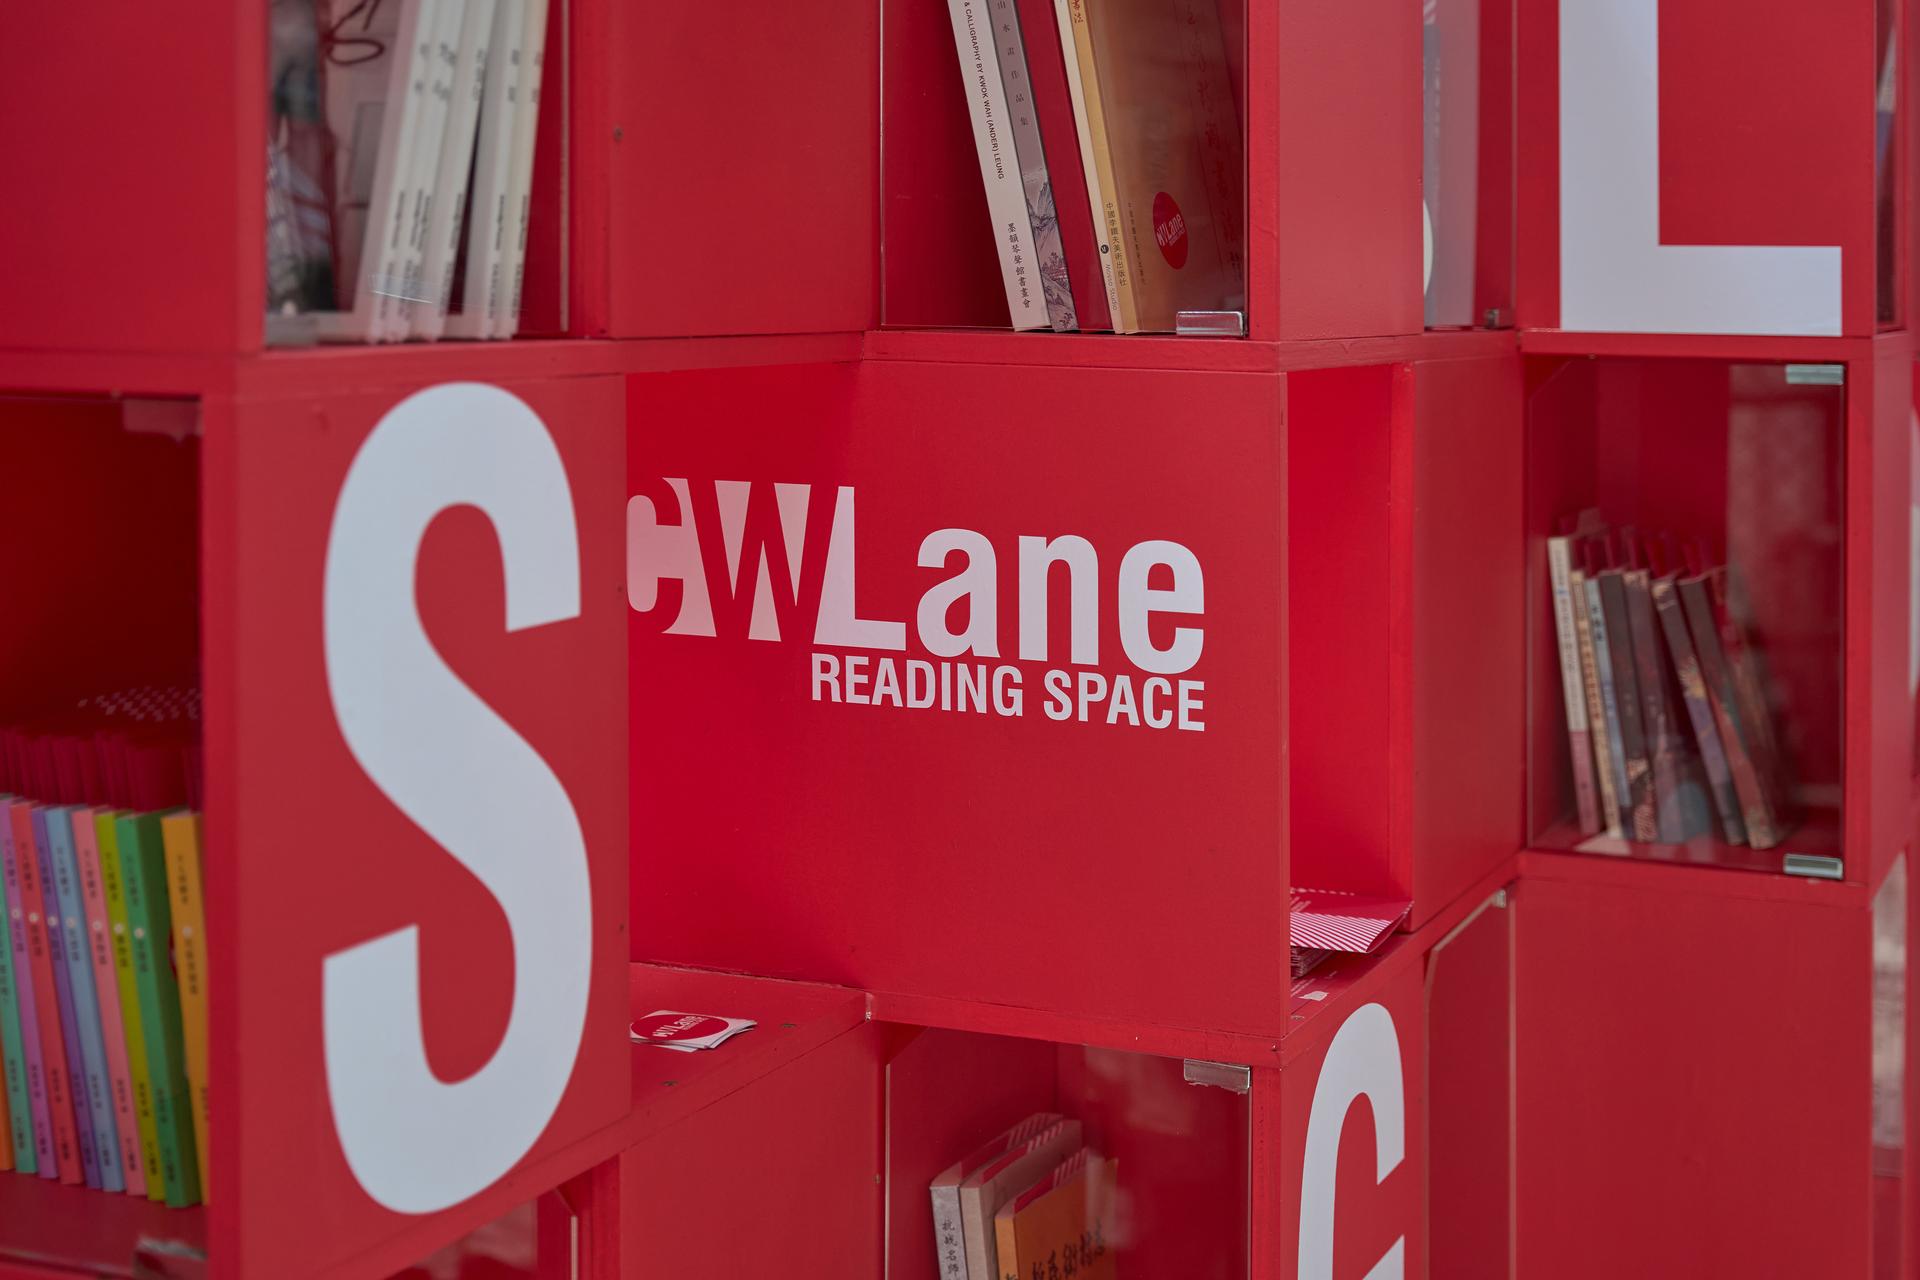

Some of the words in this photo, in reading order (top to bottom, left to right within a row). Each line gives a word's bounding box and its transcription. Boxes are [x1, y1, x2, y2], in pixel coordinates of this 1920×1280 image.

[965, 9, 981, 61] CALLIGRAPHY
[976, 63, 984, 73] BY
[979, 75, 989, 99] KWOK
[983, 99, 993, 119] WAH
[986, 119, 999, 152] (ANDER)
[993, 152, 1005, 180] LEUNG
[1560, 0, 1842, 337] L
[811, 652, 1024, 717] READING
[1043, 669, 1206, 732] SPACE
[323, 381, 592, 1214] S
